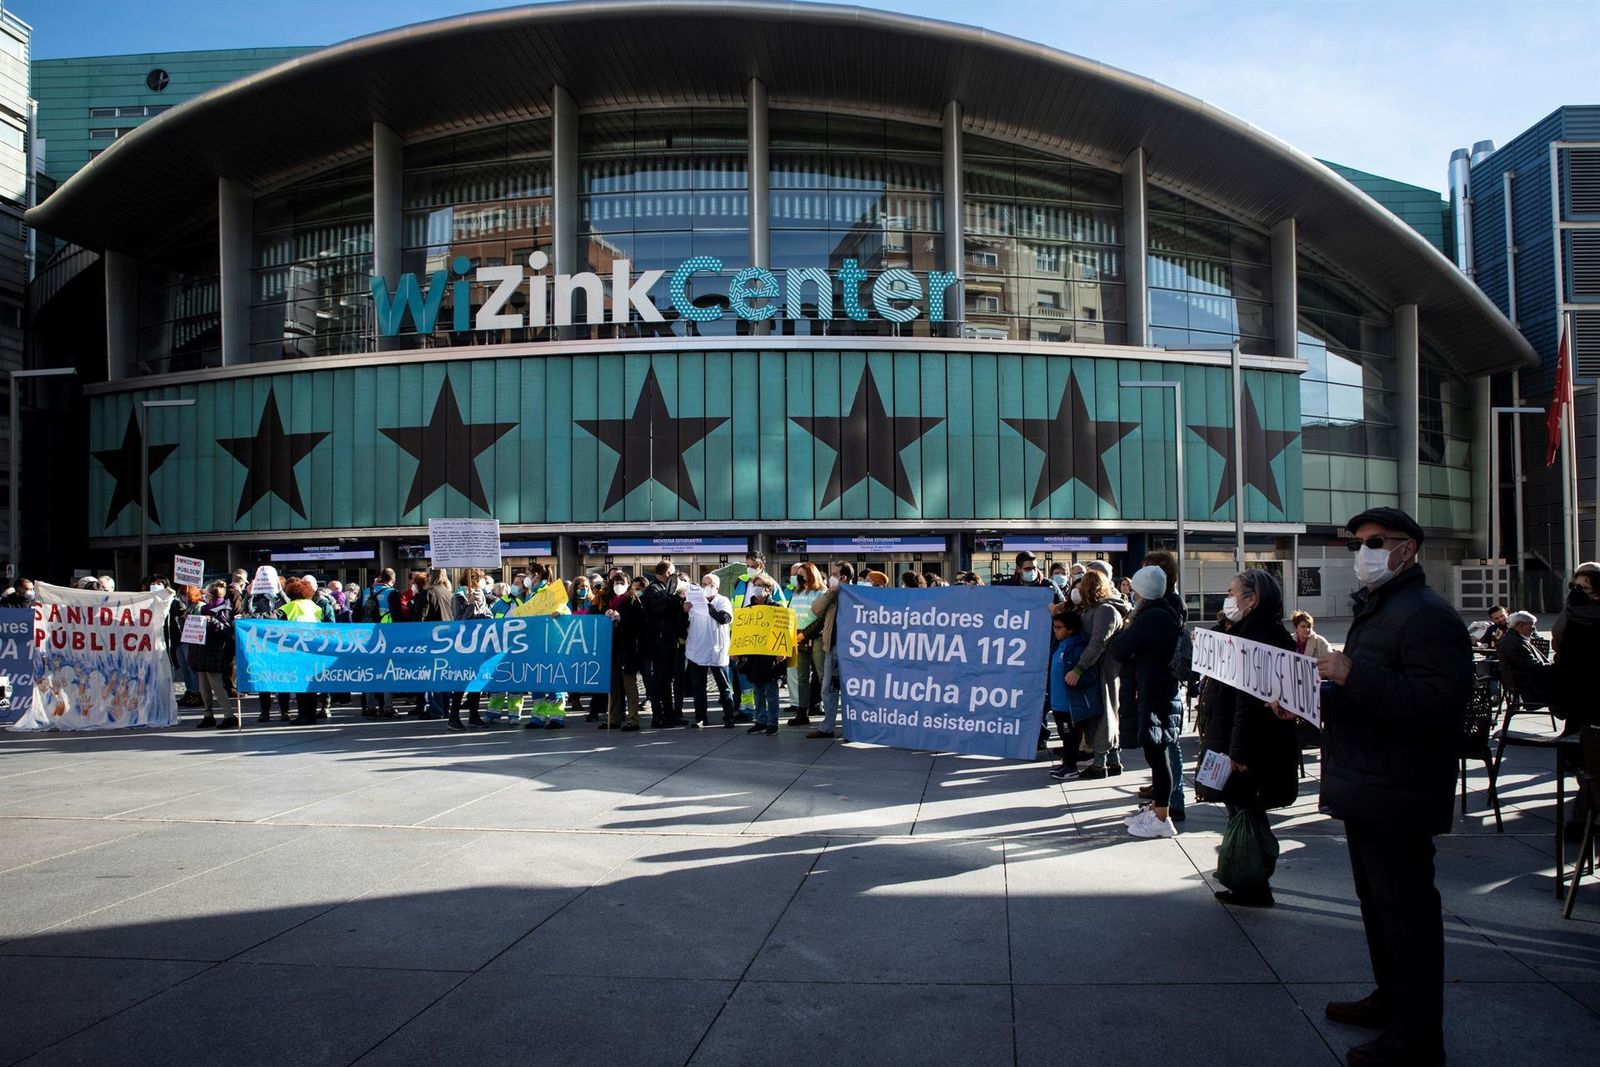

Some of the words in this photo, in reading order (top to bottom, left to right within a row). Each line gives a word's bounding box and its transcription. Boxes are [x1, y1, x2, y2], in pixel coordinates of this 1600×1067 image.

[34, 601, 153, 628] SANIDAD
[852, 604, 984, 630] Trabajadores
[993, 609, 1031, 631] del
[35, 626, 152, 652] PÚBLICA
[246, 624, 388, 655] APERTURA
[771, 630, 788, 653] YA
[849, 630, 968, 664] SUMMA
[977, 636, 1028, 667] 112
[495, 661, 569, 684] SUMMA
[570, 660, 601, 686] 112
[845, 676, 876, 698] en
[884, 673, 961, 705] lucha
[969, 685, 1025, 712] por
[846, 704, 858, 721] la
[861, 707, 919, 727] calidad
[923, 712, 1021, 736] asistencial
